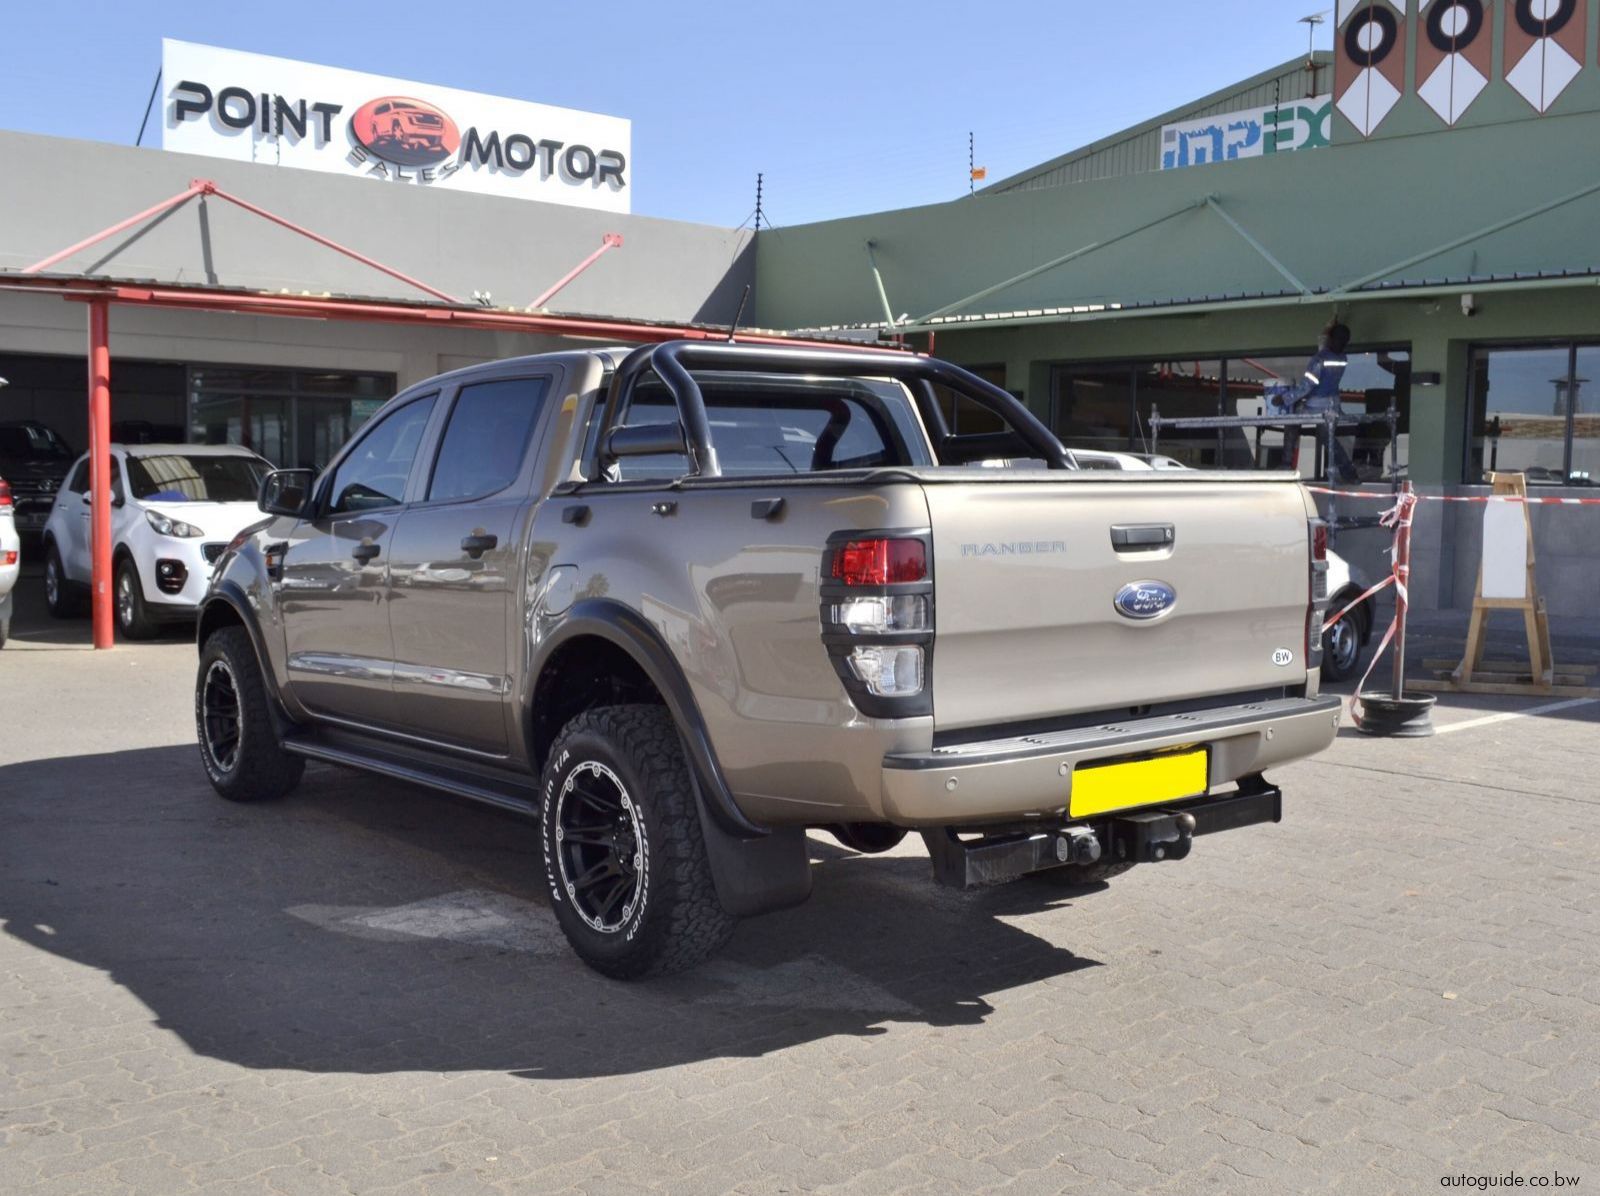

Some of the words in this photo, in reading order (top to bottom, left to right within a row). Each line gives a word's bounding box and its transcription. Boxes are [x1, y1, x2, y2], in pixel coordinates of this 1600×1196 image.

[175, 80, 343, 142] POINT
[463, 126, 626, 186] MOTOR
[351, 145, 460, 181] SALES
[961, 542, 1066, 556] RANGER
[1133, 588, 1166, 610] Ford
[1275, 652, 1290, 662] BW
[553, 750, 570, 773] T/A
